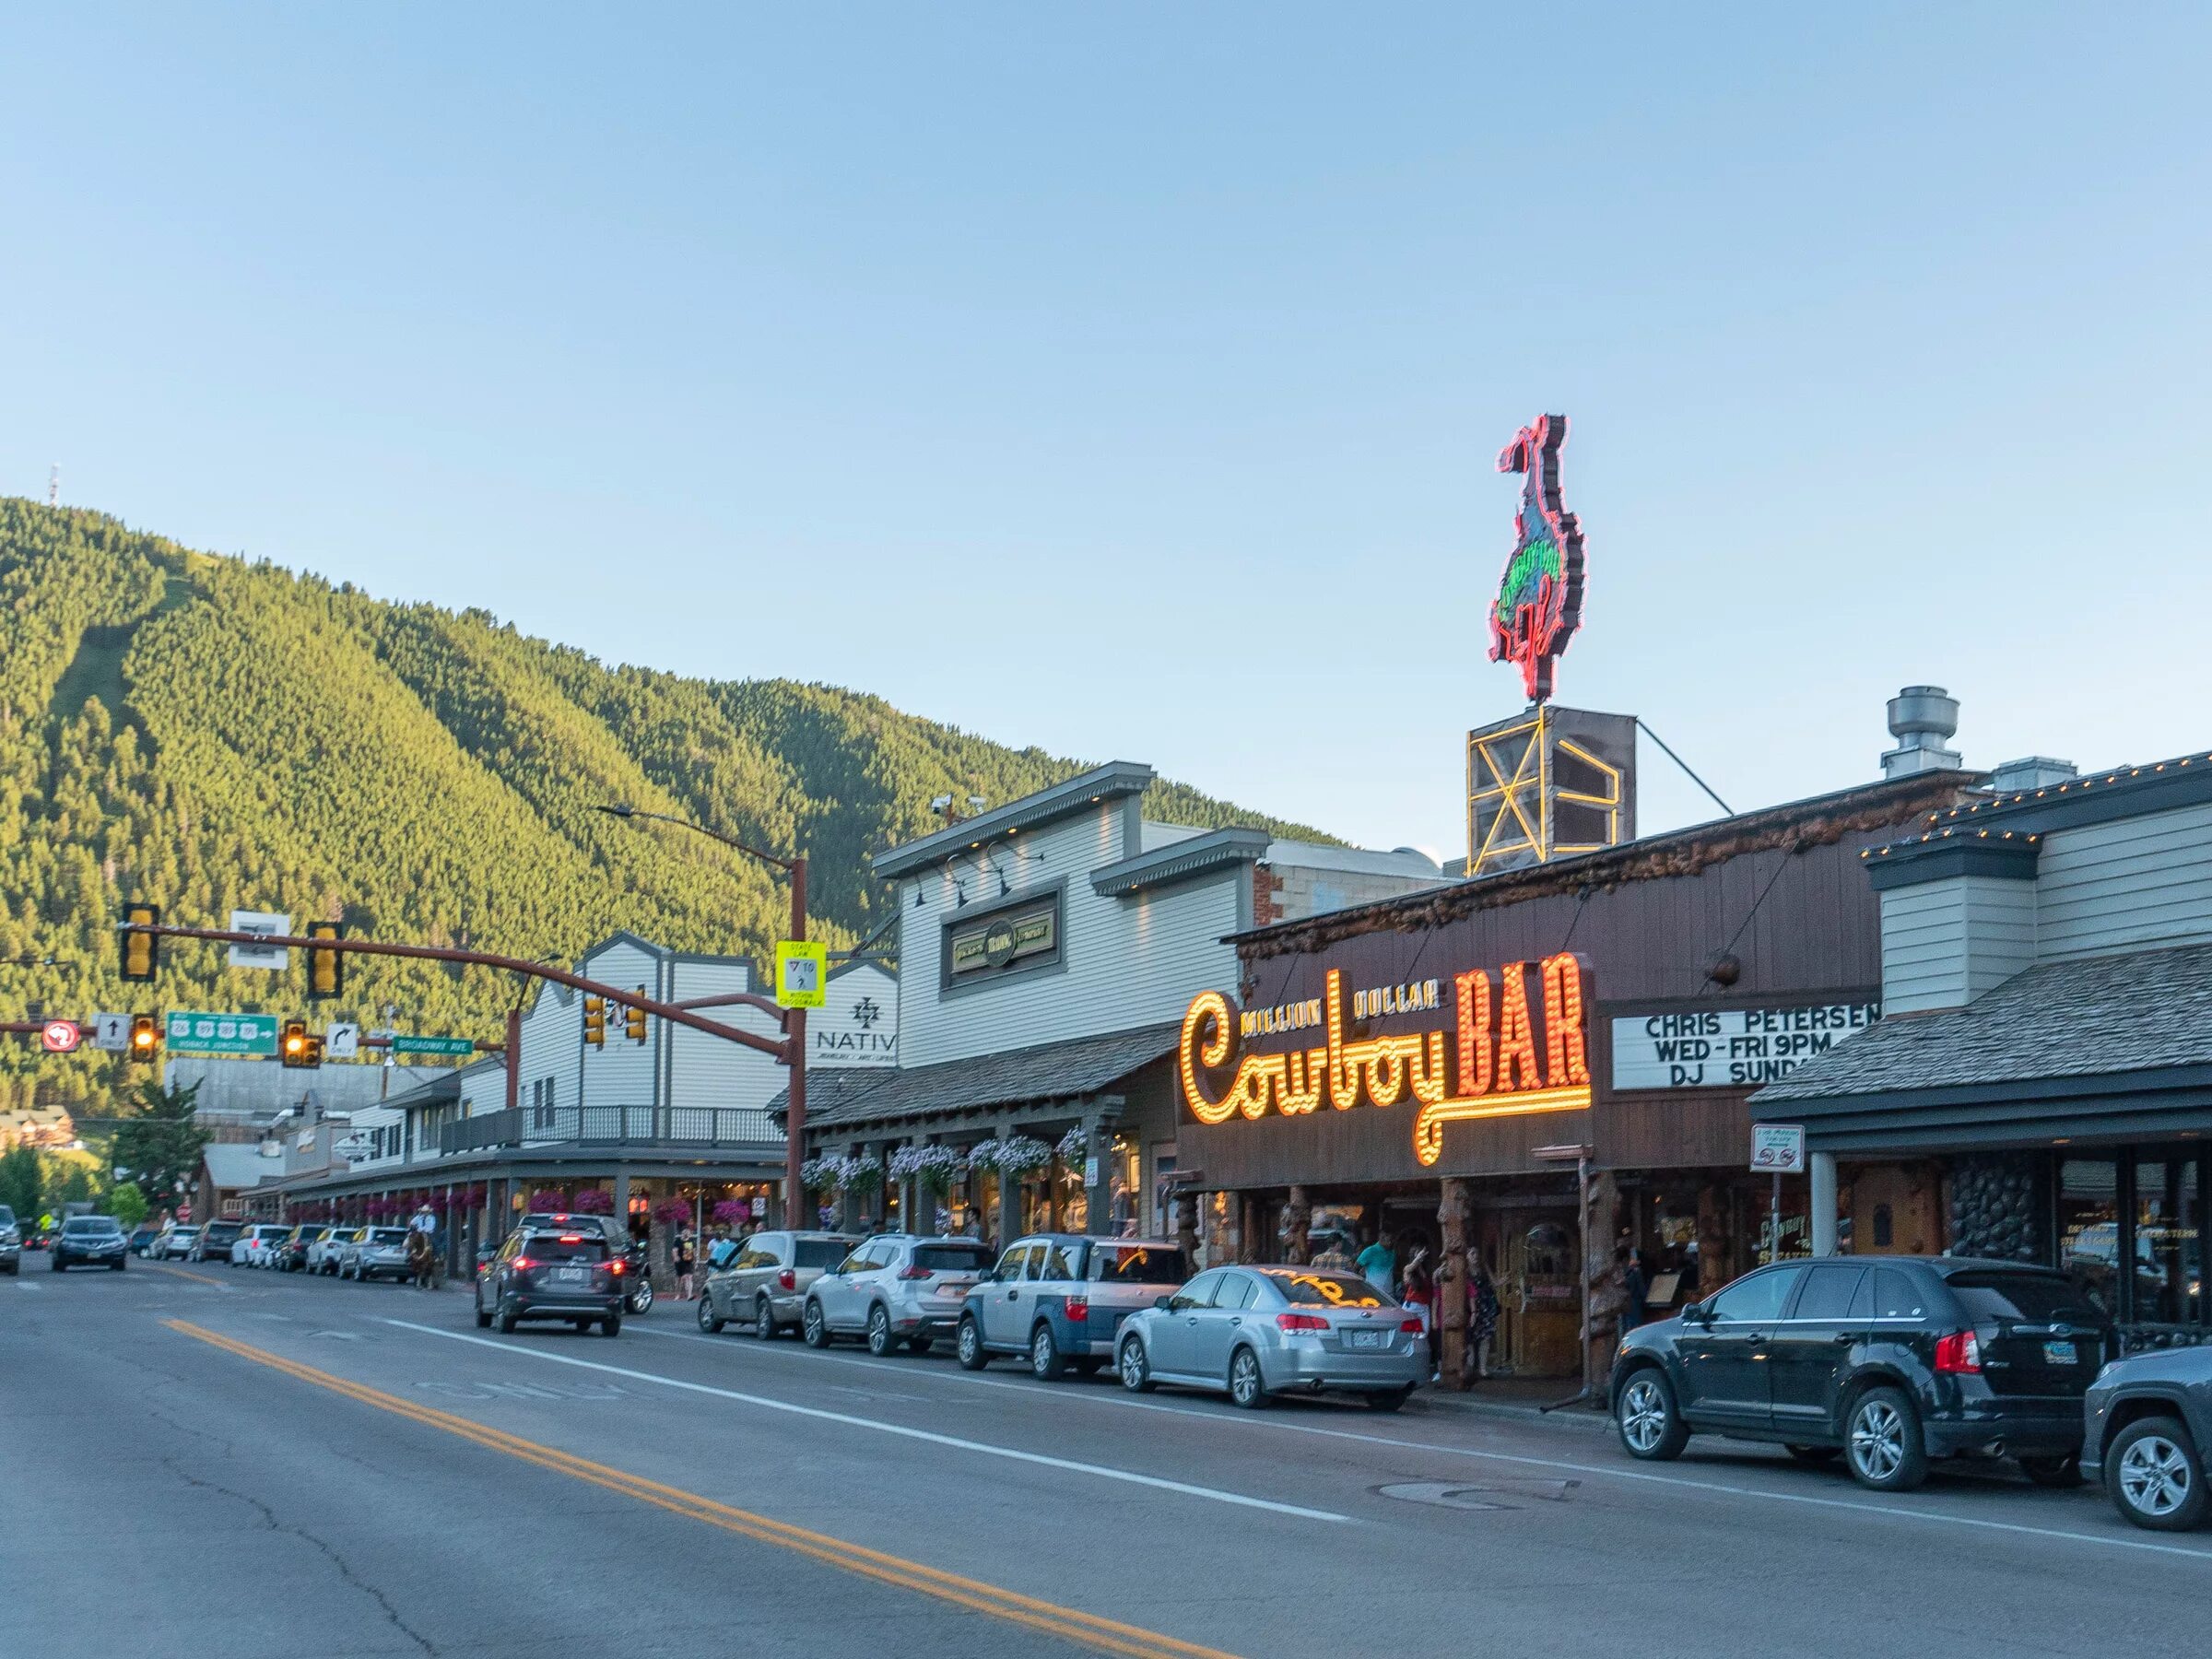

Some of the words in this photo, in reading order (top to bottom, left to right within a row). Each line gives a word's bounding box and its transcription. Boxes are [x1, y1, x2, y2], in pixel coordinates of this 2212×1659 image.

[1240, 997, 1322, 1039] MILLION
[1353, 978, 1440, 1020] DOLLAR
[1645, 1013, 1722, 1038] CHRIS
[1745, 1004, 1882, 1033] PETERSEN
[397, 1039, 447, 1050] BROADWAY
[450, 1042, 468, 1052] AVE
[817, 1031, 898, 1051] NATIV
[1180, 969, 1444, 1166] Cowboy
[1453, 951, 1591, 1096] BAR
[1670, 1064, 1704, 1086] DJ
